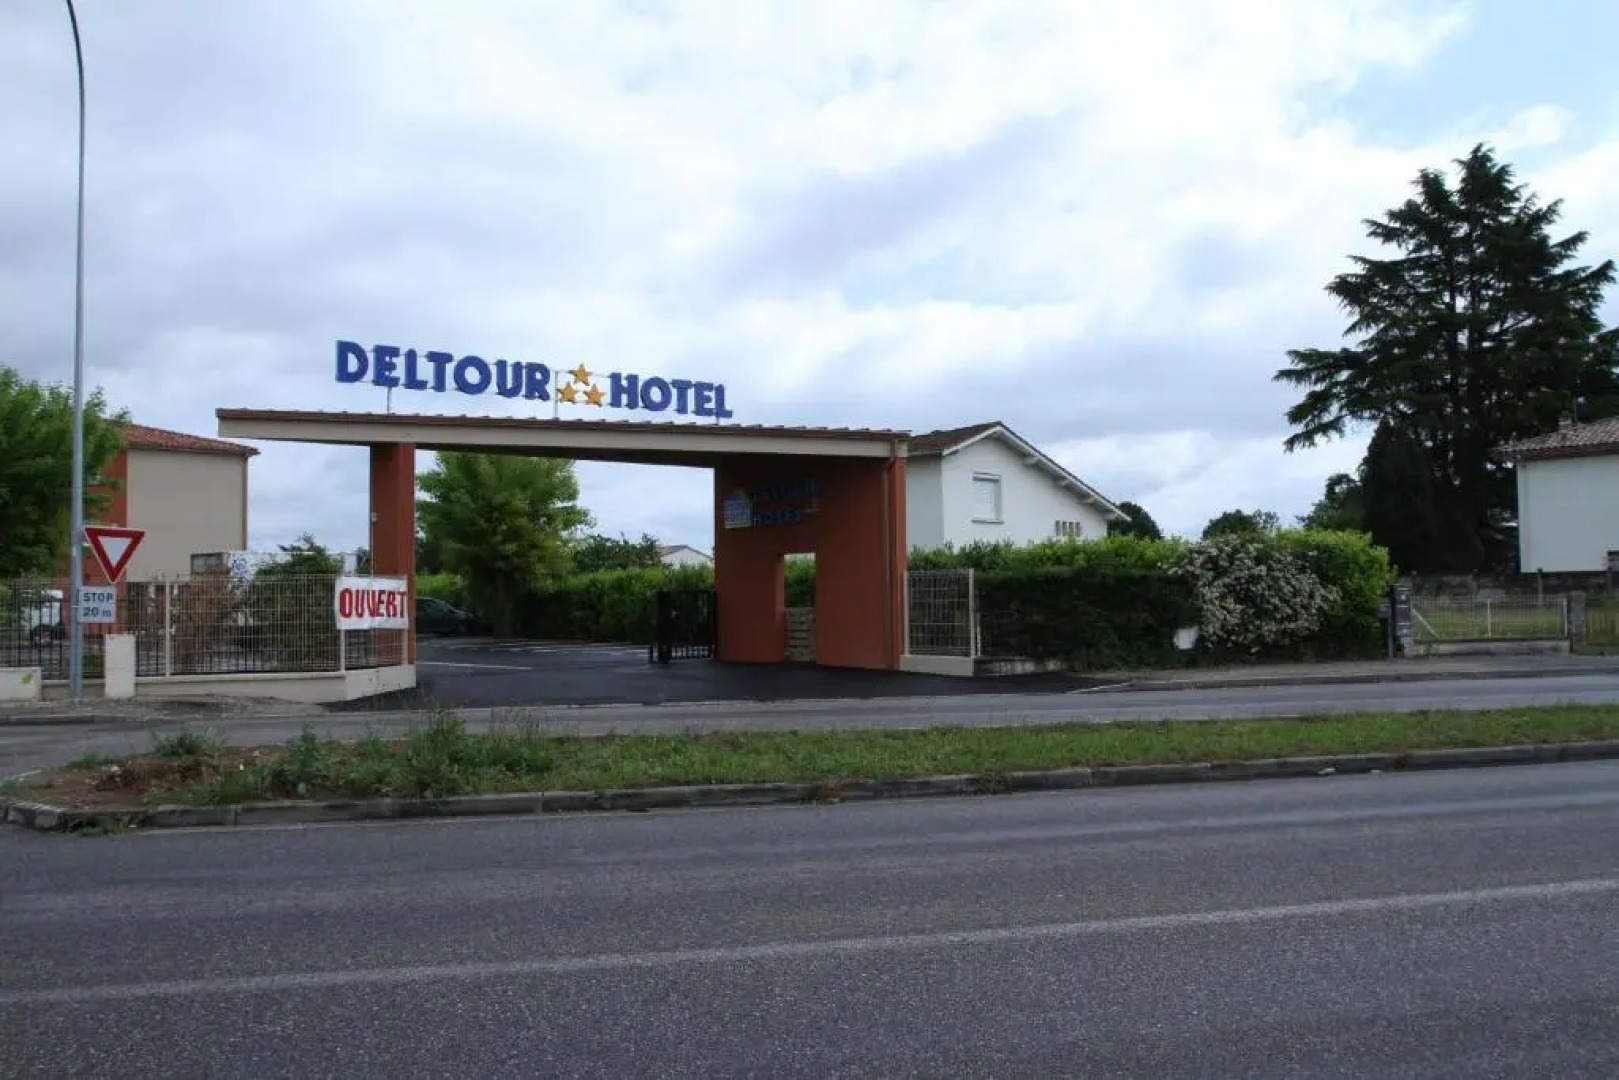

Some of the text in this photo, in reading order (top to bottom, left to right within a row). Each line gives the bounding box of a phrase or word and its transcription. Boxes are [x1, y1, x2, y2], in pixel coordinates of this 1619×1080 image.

[336, 340, 733, 418] DELTOUR HOTEL
[83, 592, 114, 602] STOP
[339, 588, 407, 618] OUVERT
[83, 607, 112, 617] 20 m
